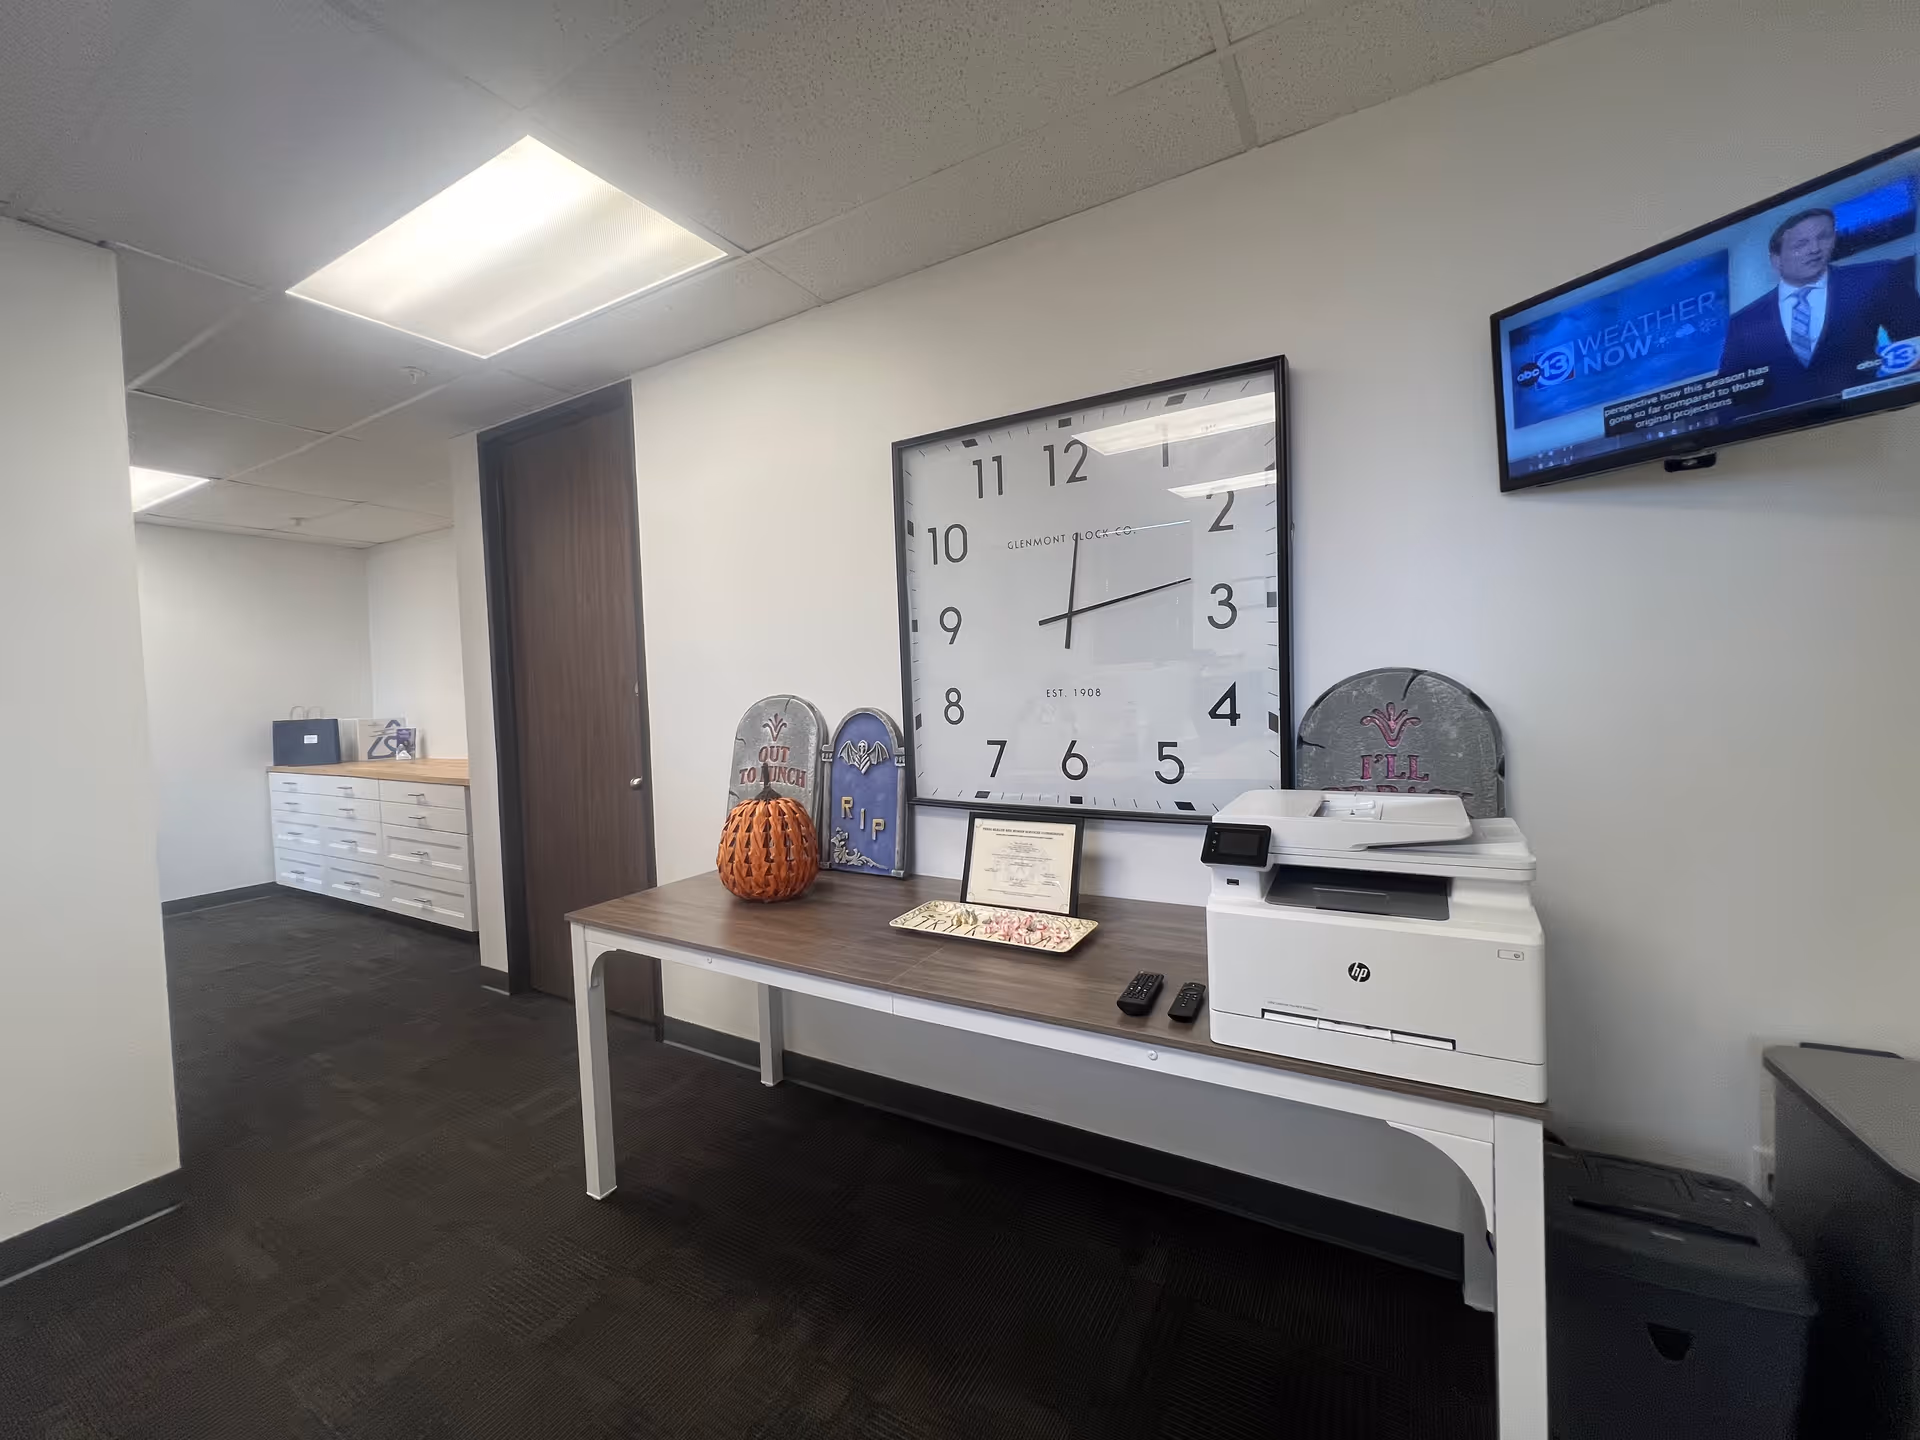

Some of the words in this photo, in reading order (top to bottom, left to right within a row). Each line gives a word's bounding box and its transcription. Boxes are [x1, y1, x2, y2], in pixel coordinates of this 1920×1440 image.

[1577, 291, 1715, 356] WEATHER
[1517, 368, 1540, 383] abc
[1543, 354, 1569, 378] 13
[1583, 336, 1651, 375] NOW
[1885, 346, 1914, 367] 13
[1604, 396, 1658, 418] perspective
[1660, 390, 1681, 401] how
[1684, 384, 1703, 395] this
[1705, 372, 1745, 389] season
[1748, 366, 1769, 377] has
[1609, 413, 1632, 427] gone
[1634, 410, 1646, 419] so
[1648, 406, 1662, 415] far
[1664, 390, 1715, 411] compared
[1718, 388, 1730, 397] to
[1732, 379, 1764, 393] those
[1635, 412, 1671, 429] original
[1673, 398, 1733, 420] projections
[972, 455, 1003, 499] 11
[1043, 439, 1087, 486] 12
[1206, 488, 1235, 532] 2
[927, 523, 968, 565] 10
[1007, 534, 1066, 550] GLENMONT
[1115, 525, 1136, 537] CO.
[1207, 583, 1238, 629] 3
[939, 607, 962, 645] 9
[944, 687, 965, 725] 8
[1046, 688, 1067, 698] EST.
[1074, 688, 1101, 697] 1908
[1207, 682, 1241, 726] 4
[759, 746, 790, 762] OUT
[986, 740, 1008, 777] 7
[1061, 740, 1089, 780] 6
[1154, 741, 1185, 784] 5
[1360, 753, 1430, 782] I'LL
[739, 767, 756, 784] TO
[1350, 962, 1370, 982] hp
